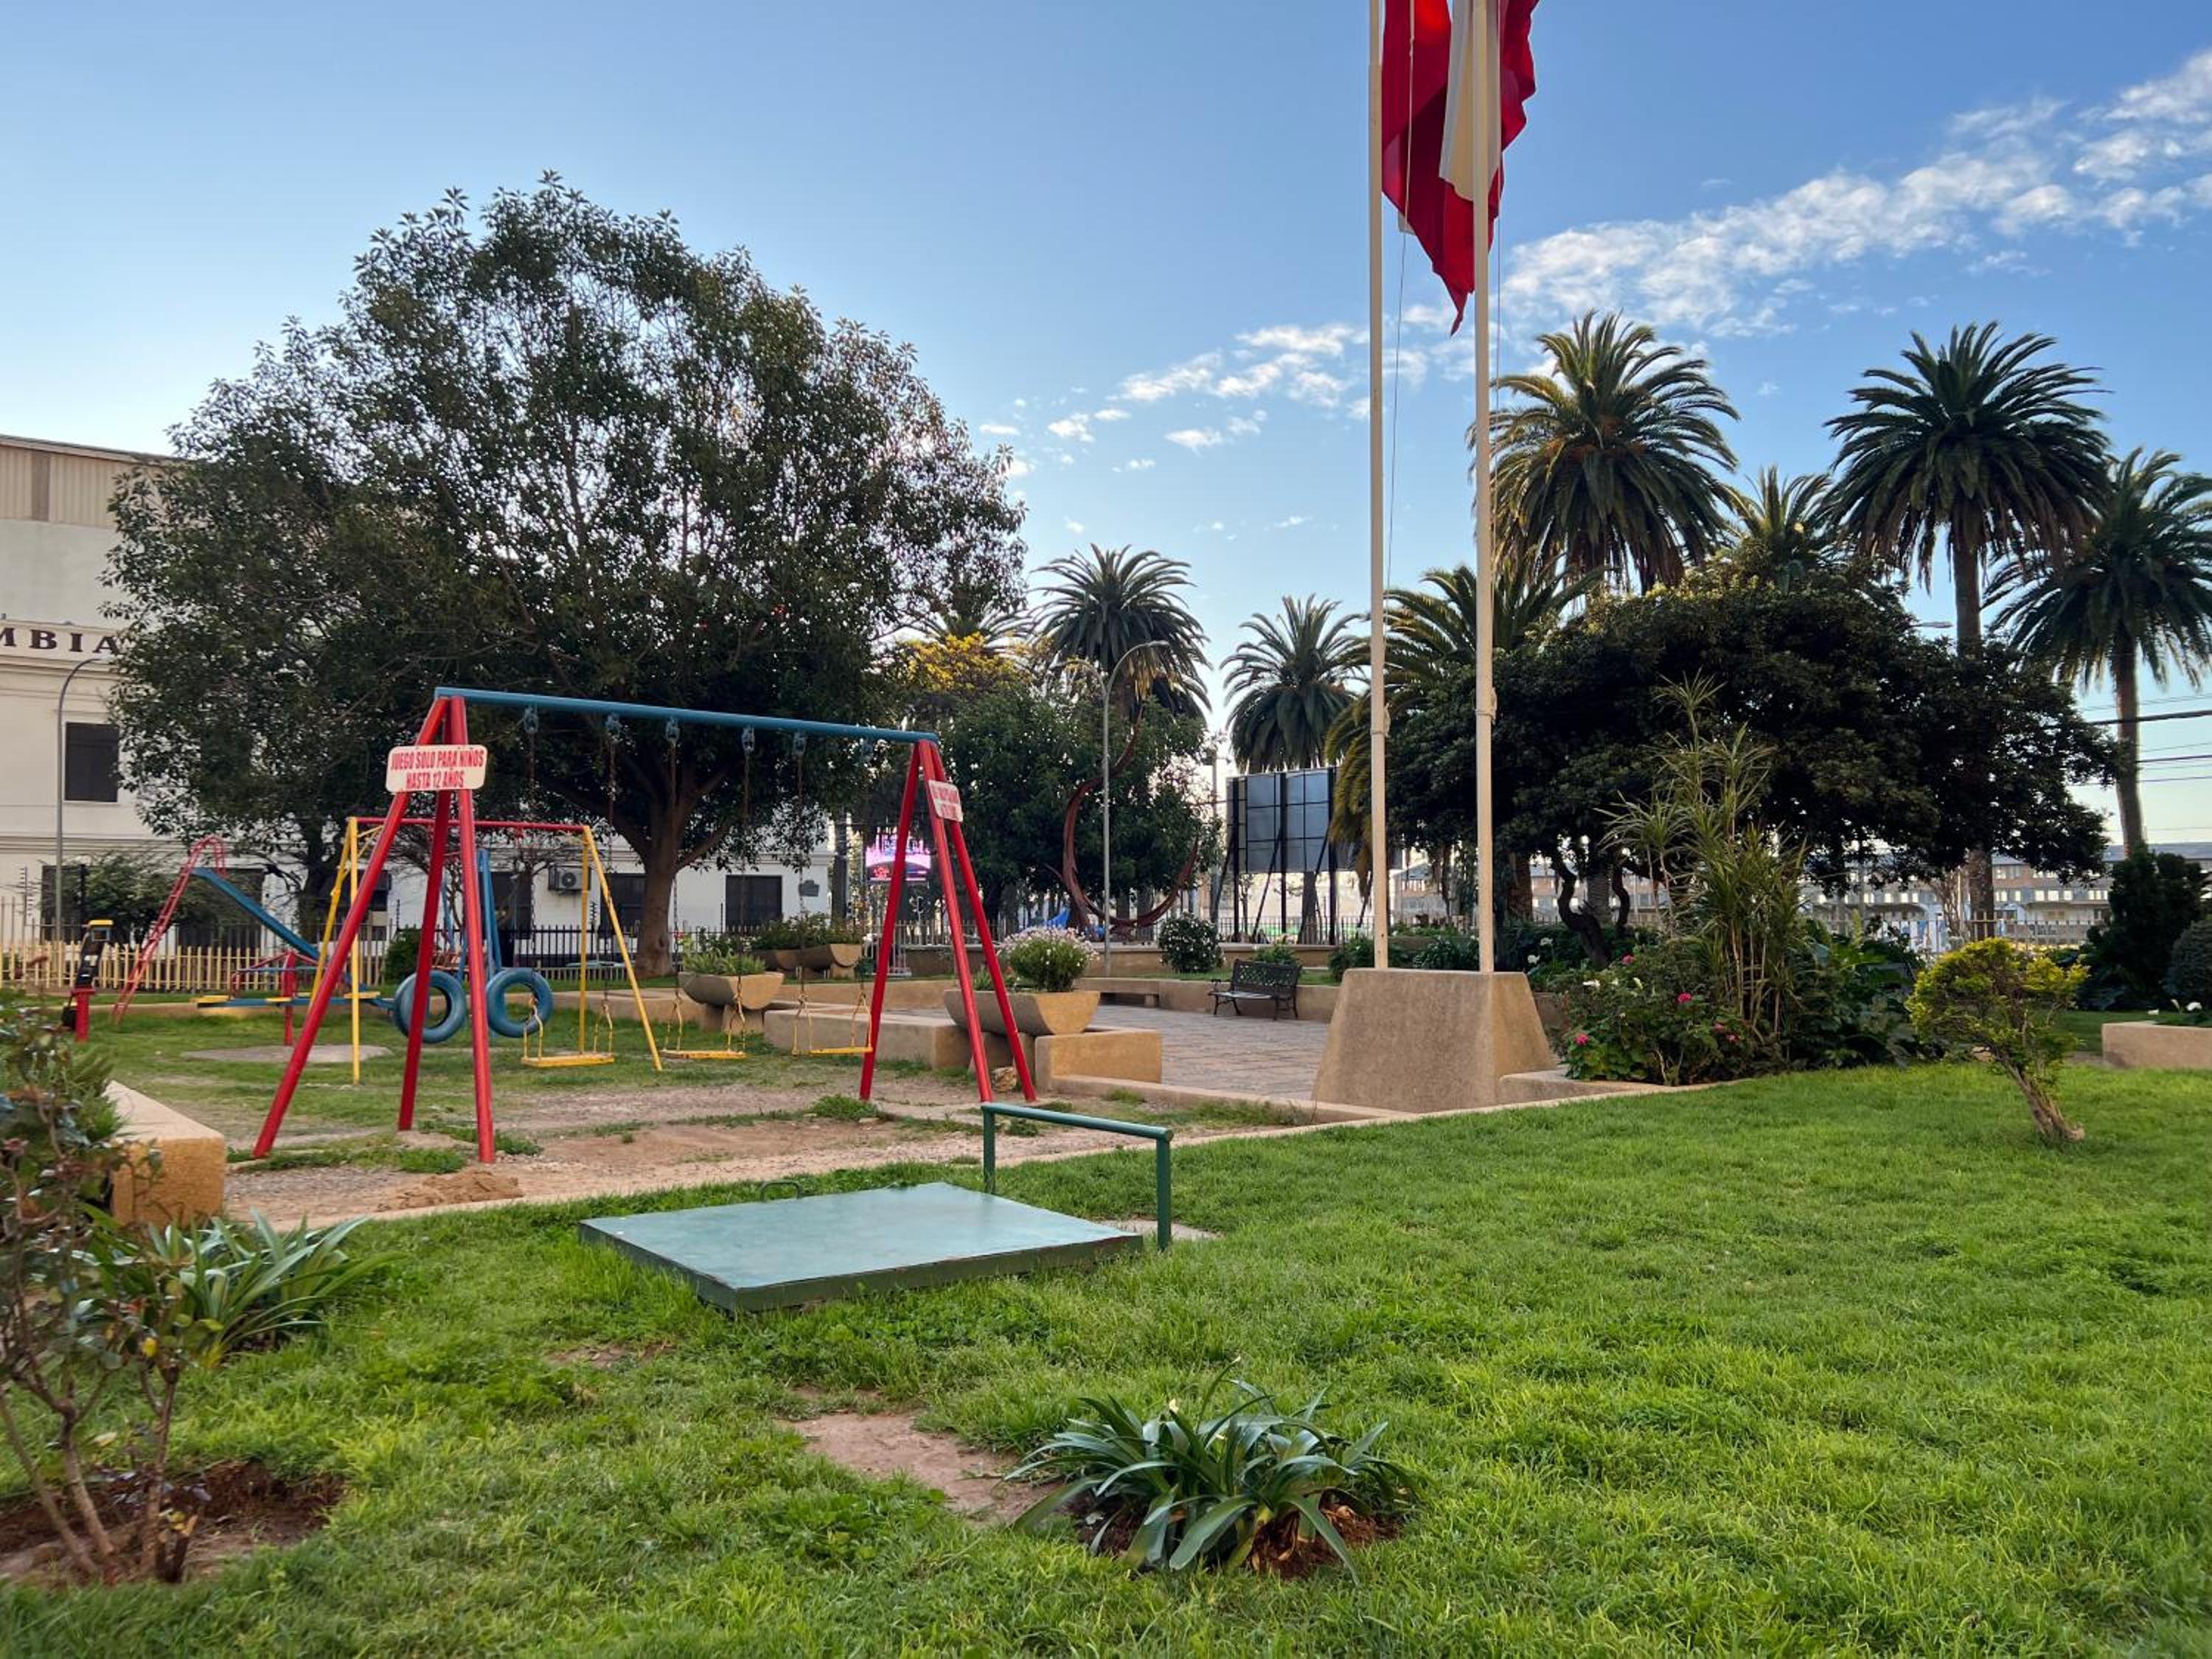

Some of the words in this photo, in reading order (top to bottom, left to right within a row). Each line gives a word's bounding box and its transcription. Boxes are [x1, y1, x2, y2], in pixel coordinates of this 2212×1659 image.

[391, 753, 414, 770] JUEGO
[416, 752, 435, 768] SOLO
[437, 751, 457, 767] PARA
[459, 748, 484, 768] NIÑOS
[406, 772, 431, 788] HASTA
[433, 771, 442, 787] 12
[442, 768, 465, 787] AÑOS
